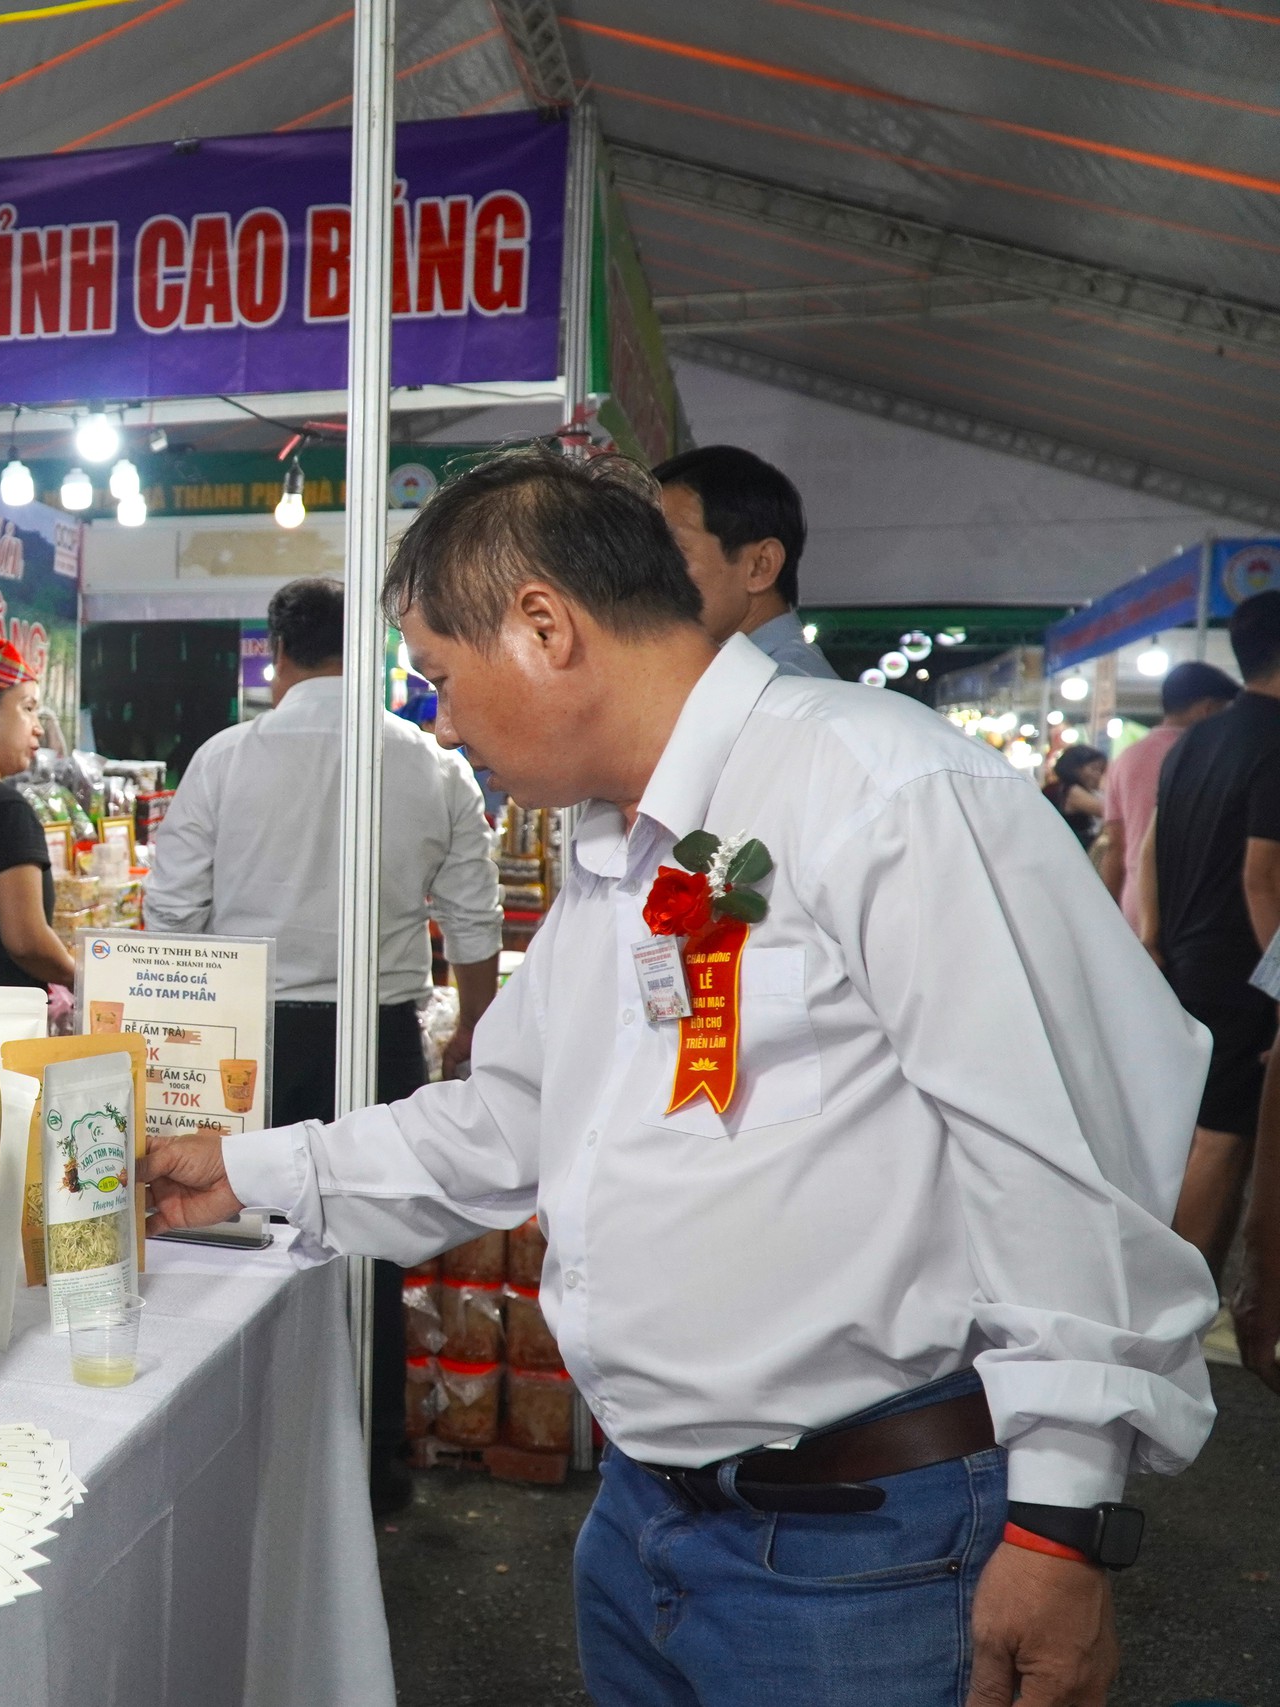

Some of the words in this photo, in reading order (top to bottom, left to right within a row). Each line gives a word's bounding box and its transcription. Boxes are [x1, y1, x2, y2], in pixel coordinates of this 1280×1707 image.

[133, 207, 288, 334] CAO
[117, 943, 145, 955] CÔNG
[147, 947, 161, 956] TY
[162, 948, 192, 958] TNHH
[194, 947, 208, 958] BÁ
[210, 950, 239, 960] NINH
[132, 957, 152, 965] NINH
[176, 959, 204, 970] KHÁNH
[136, 969, 165, 982] BẢNG
[166, 971, 188, 983] BÁO
[190, 972, 208, 985] GIÁ
[700, 966, 713, 990] LỄ
[129, 983, 153, 997] XÁO
[155, 988, 180, 999] TAM
[182, 987, 216, 1002] PHÂN
[693, 996, 706, 1009] HAI
[162, 1026, 186, 1039] TRÀ)
[183, 1070, 207, 1084] SẮC)
[169, 1082, 190, 1091] 100GR
[162, 1091, 201, 1108] 170K
[94, 1147, 108, 1159] TAM
[108, 1146, 124, 1160] PHÂN
